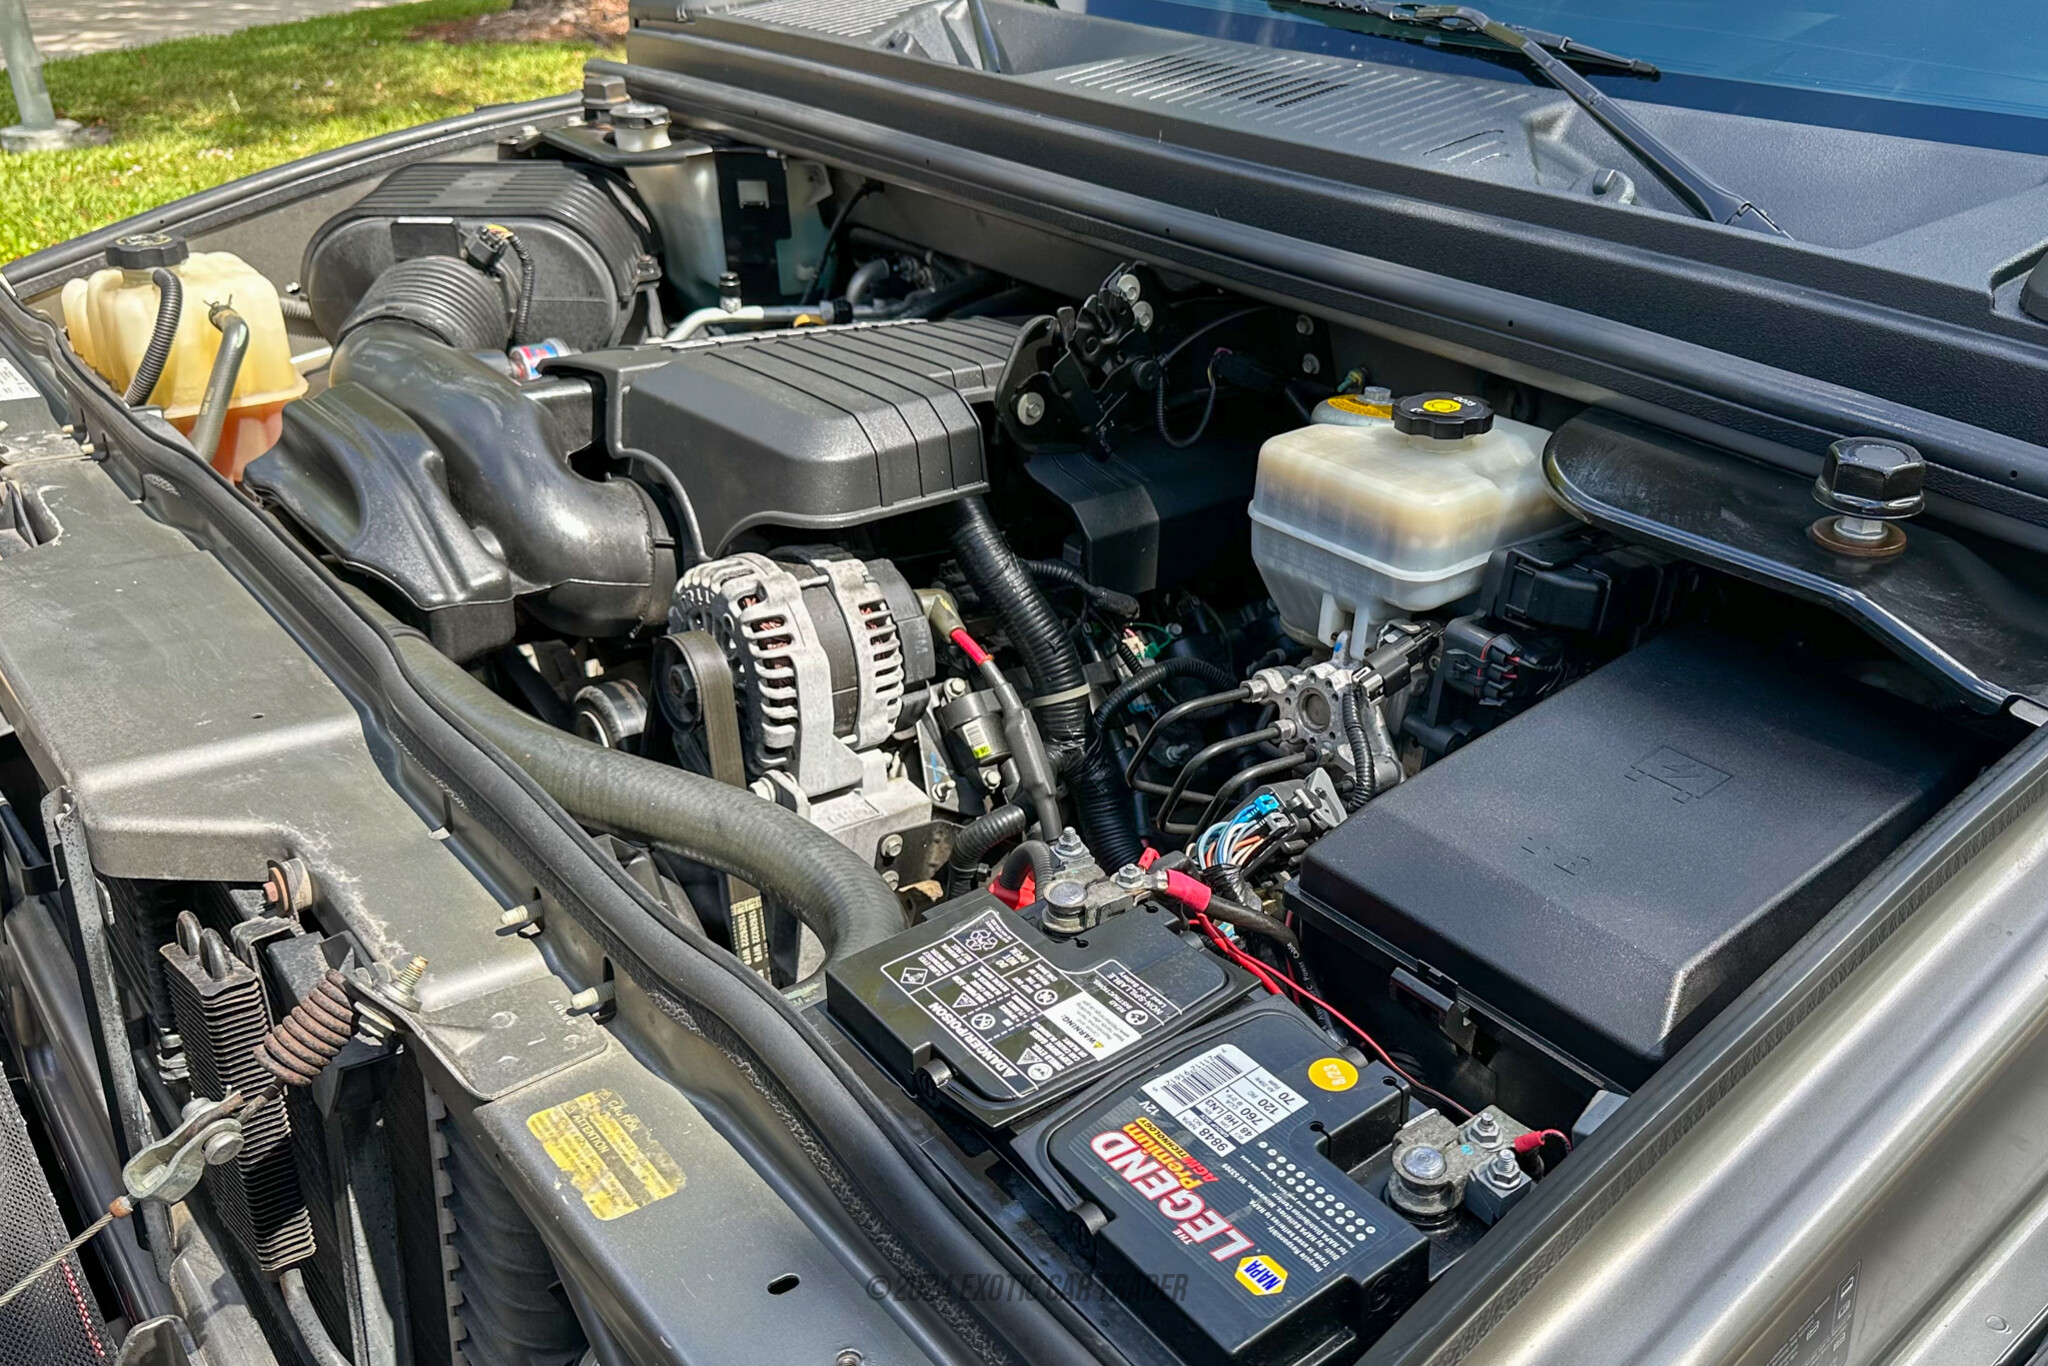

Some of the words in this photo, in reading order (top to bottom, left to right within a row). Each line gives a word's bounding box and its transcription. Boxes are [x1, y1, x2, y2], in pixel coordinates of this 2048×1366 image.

[1285, 940, 1300, 960] Cable
[1001, 953, 1020, 966] NOT
[1116, 970, 1141, 987] Battery
[1105, 972, 1165, 1015] NON-SPILLABLE
[1136, 985, 1152, 997] Acid
[1107, 999, 1127, 1013] READ
[1149, 995, 1167, 1008] Lead
[927, 1001, 1009, 1071] DANGER/POISON
[1058, 1014, 1097, 1044] WARNING:
[1204, 1098, 1224, 1114] LN3
[1256, 1097, 1280, 1115] 120
[1276, 1090, 1296, 1105] 70
[1138, 1098, 1161, 1116] 12V
[1180, 1116, 1198, 1130] NAPA
[1222, 1113, 1239, 1126] H6
[1238, 1106, 1264, 1126] 760
[1137, 1116, 1187, 1158] TECHNOLOGY
[1197, 1127, 1229, 1152] 9848
[1238, 1126, 1254, 1138] 48
[1121, 1121, 1204, 1190] Premium
[1179, 1152, 1219, 1186] AGM
[1236, 1175, 1248, 1184] WI
[1088, 1130, 1255, 1262] LEGEND
[1270, 1191, 1293, 1210] Centers
[1268, 1215, 1296, 1239] batteries
[1289, 1207, 1324, 1236] Distribution
[1171, 1226, 1194, 1245] THE
[1291, 1235, 1309, 1249] used
[1298, 1226, 1317, 1242] NAPA
[1320, 1232, 1339, 1248] NAPA
[1304, 1246, 1315, 1254] in
[1314, 1238, 1326, 1248] by
[1336, 1245, 1348, 1255] for
[1298, 1251, 1324, 1273] Recycle
[1311, 1251, 1331, 1267] Trade
[1242, 1258, 1281, 1291] NAPA
